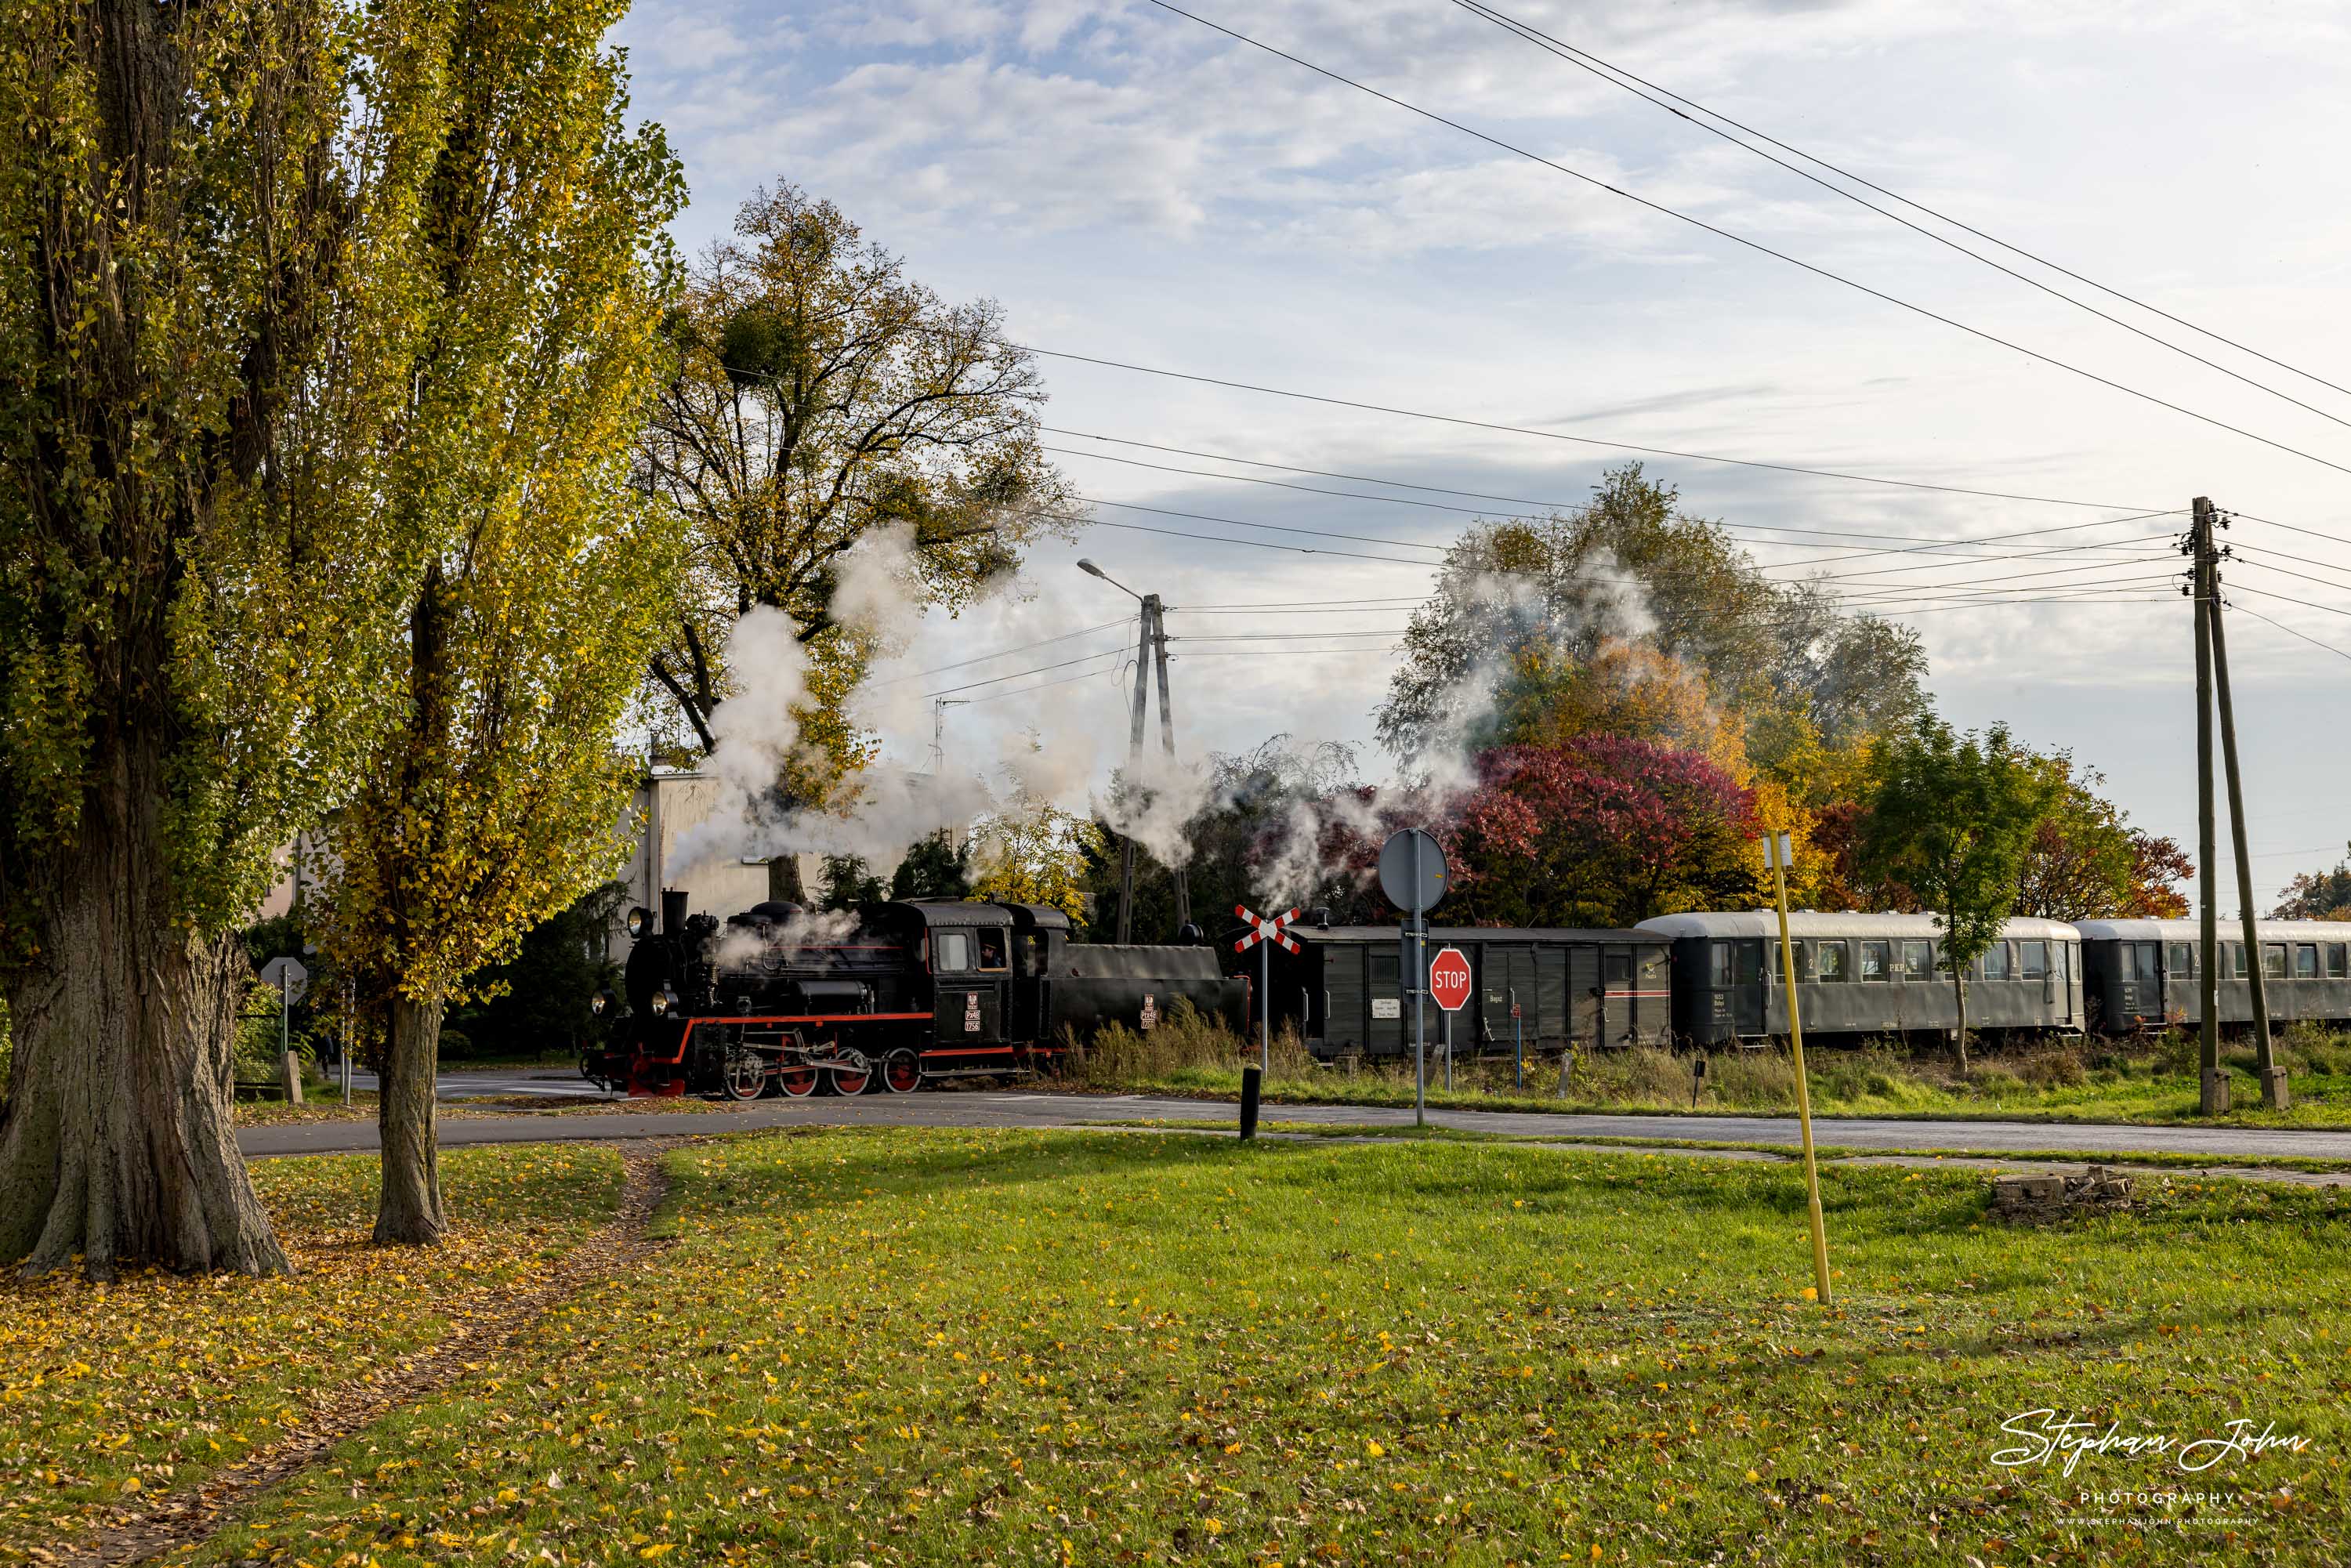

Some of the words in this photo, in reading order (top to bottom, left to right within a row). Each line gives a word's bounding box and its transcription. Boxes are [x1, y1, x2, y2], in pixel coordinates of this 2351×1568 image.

[1808, 958, 1814, 969] 2
[2012, 958, 2017, 968] 2
[2194, 954, 2200, 967] 2
[1436, 971, 1467, 989] STOP
[966, 1011, 980, 1019] Px48
[965, 1022, 979, 1030] 1756
